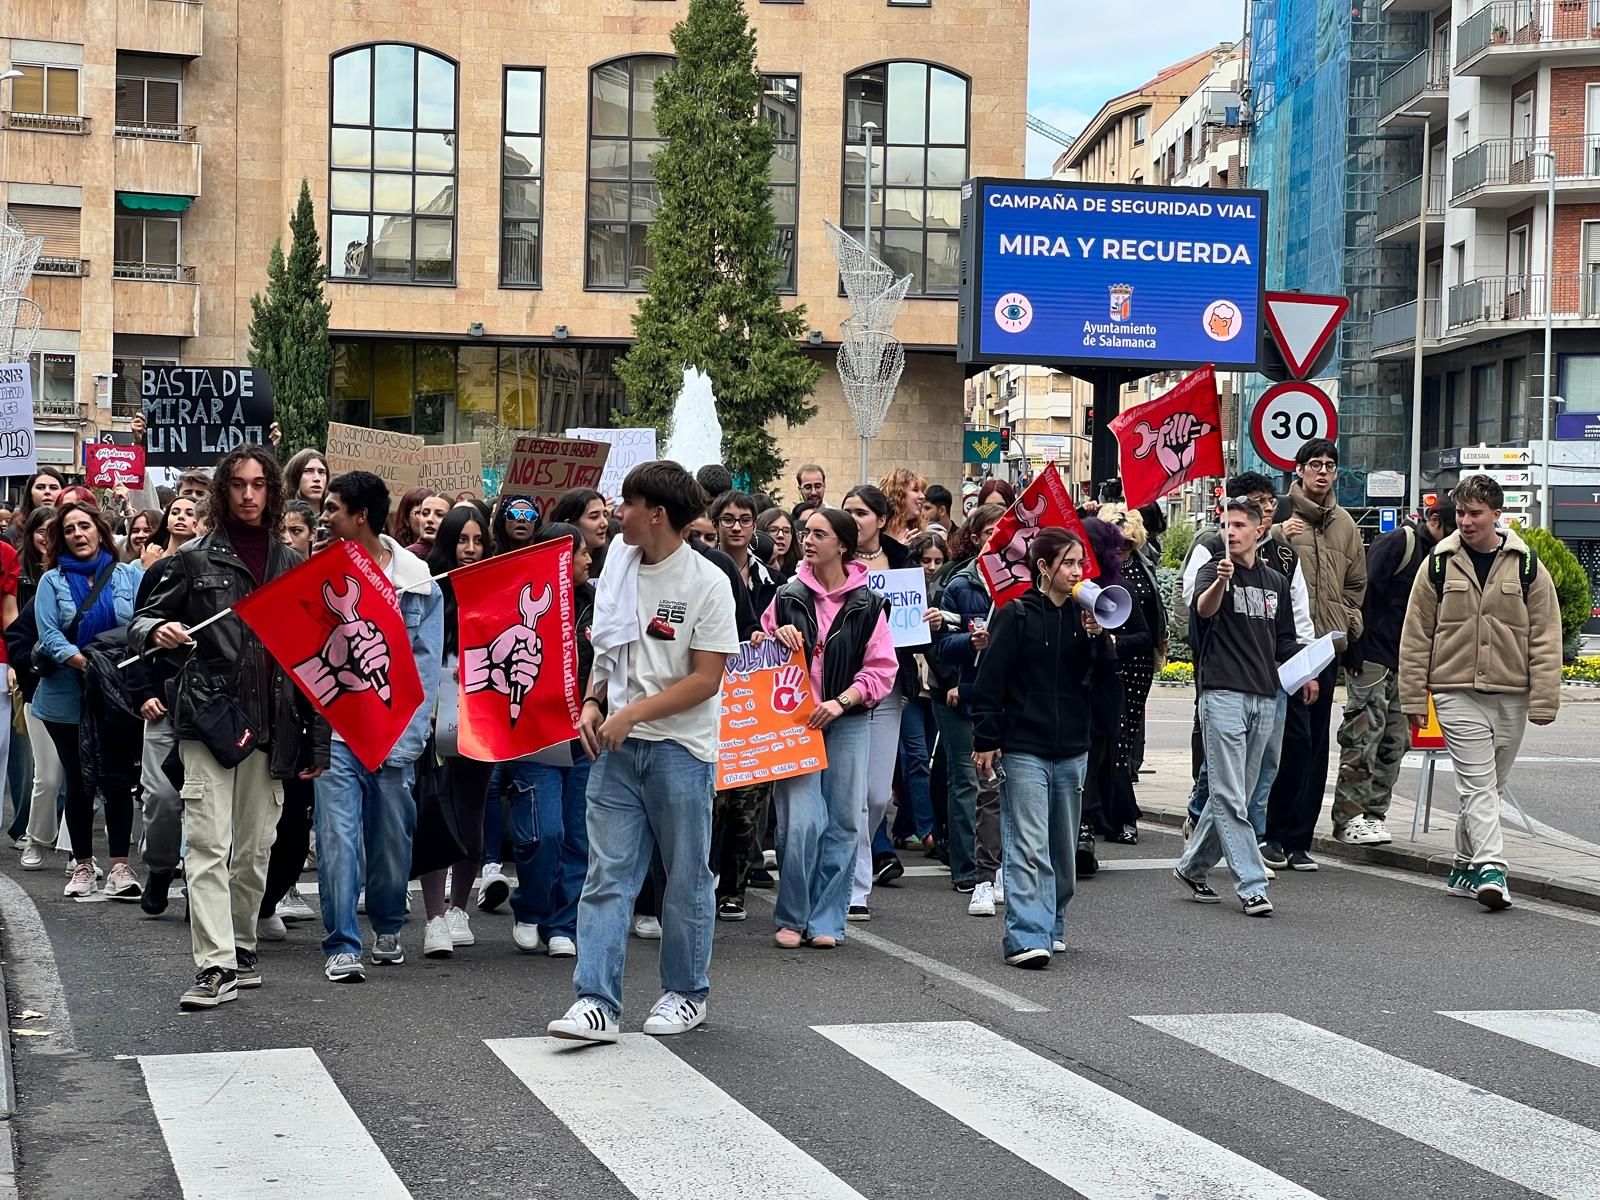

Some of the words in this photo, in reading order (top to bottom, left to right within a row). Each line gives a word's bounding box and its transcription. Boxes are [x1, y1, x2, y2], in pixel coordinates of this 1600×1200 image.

[989, 193, 1078, 211] CAMPAÑA
[1083, 198, 1106, 212] DE
[1111, 199, 1213, 217] SEGURIDAD
[1217, 203, 1256, 219] VIAL
[1000, 234, 1070, 257] MIRA
[1077, 237, 1095, 258] Y
[1103, 238, 1251, 265] RECUERDA
[1083, 320, 1157, 335] Ayuntamiento
[1083, 334, 1096, 346] de
[1099, 335, 1156, 348] Salamanca
[142, 368, 219, 396] BASTA
[222, 369, 253, 397] DE
[142, 398, 224, 424] MIRAR
[231, 397, 245, 424] A
[331, 424, 342, 438] NO
[344, 426, 375, 444] SOMOS
[1271, 411, 1318, 440] 30
[147, 426, 187, 452] UN
[200, 425, 262, 452] LADO
[327, 438, 362, 458] SOMOS
[375, 464, 400, 480] QUE
[433, 460, 472, 477] JUEGO
[343, 542, 384, 592] Sindicato
[558, 551, 571, 621] Sindicato
[884, 591, 921, 607] MENTA
[656, 608, 686, 624] 95
[561, 621, 572, 641] de
[562, 642, 582, 731] Estudiantes
